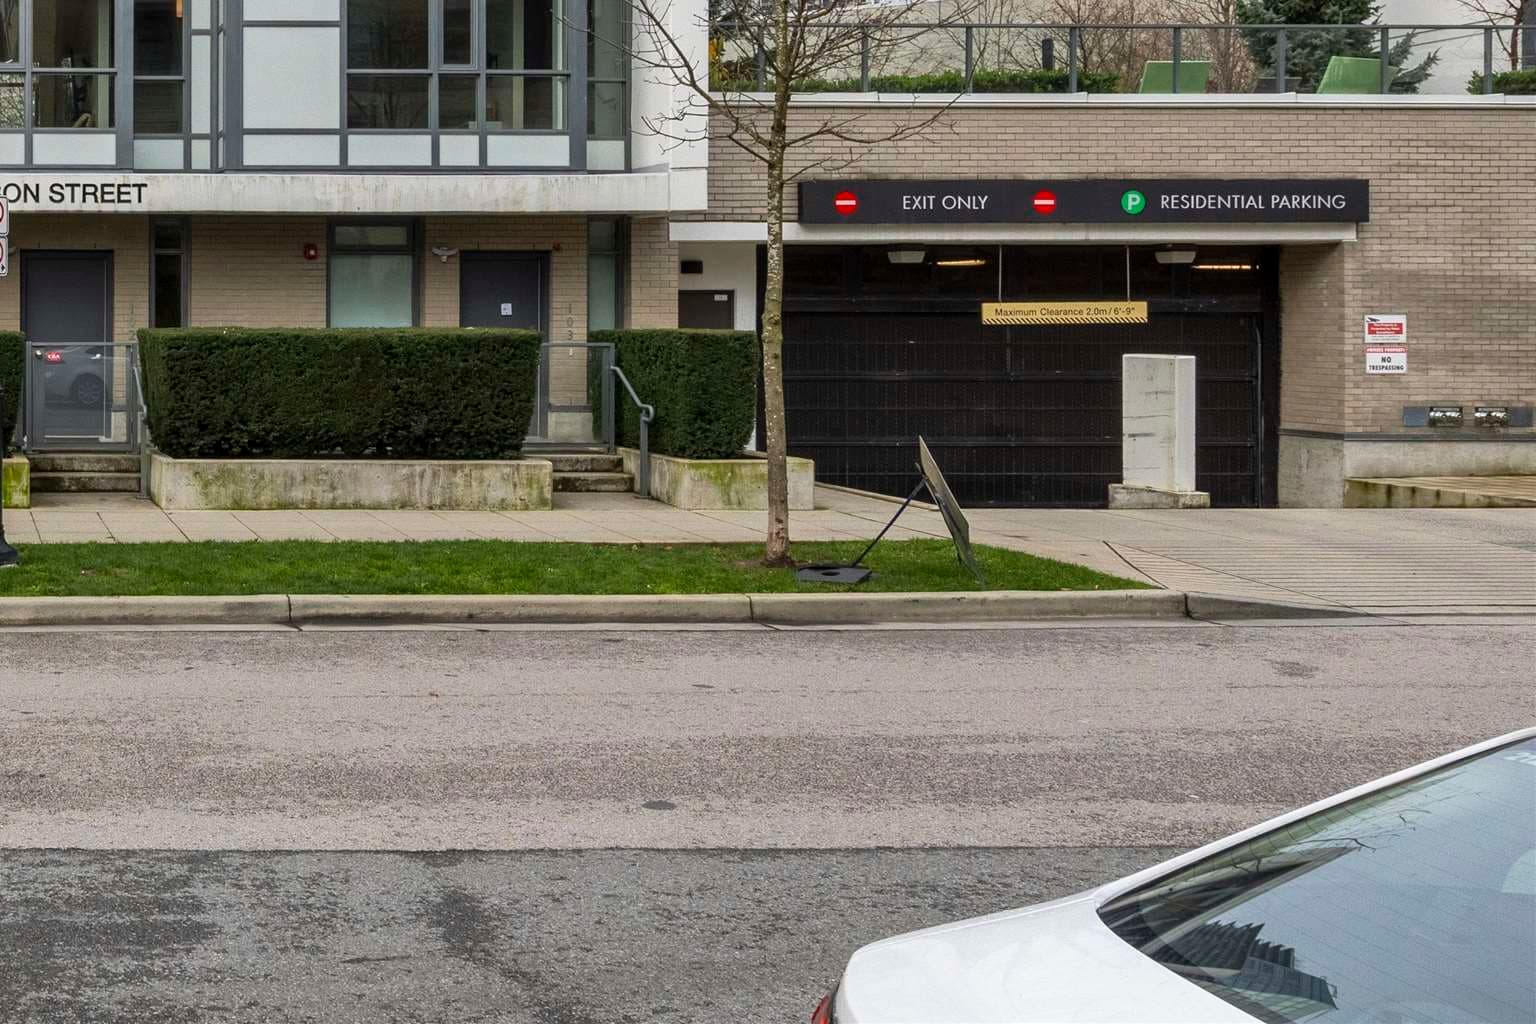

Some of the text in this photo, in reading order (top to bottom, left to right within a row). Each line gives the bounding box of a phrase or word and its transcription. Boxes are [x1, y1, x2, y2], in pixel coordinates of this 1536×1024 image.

[49, 183, 148, 203] STREET
[902, 195, 989, 210] EXIT ONLY
[1128, 194, 1140, 211] P
[1161, 194, 1346, 209] RESIDENTIAL PARKING
[994, 308, 1037, 317] Maximum
[1040, 307, 1084, 316] Clearance
[1086, 307, 1107, 316] 2.0m
